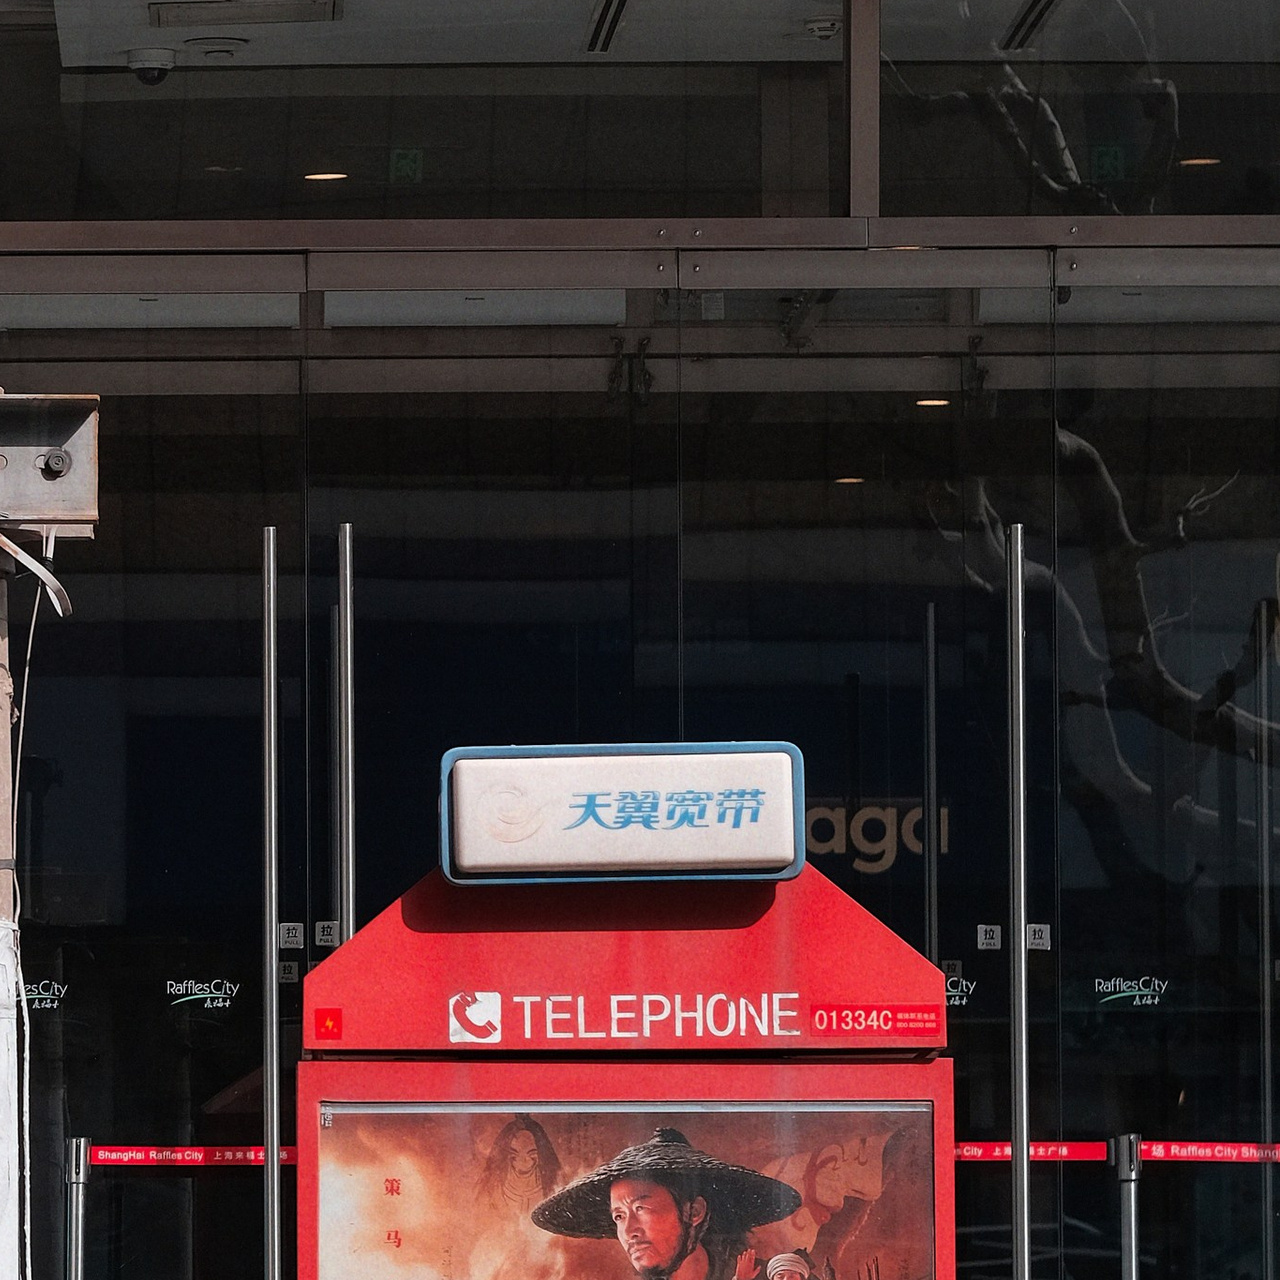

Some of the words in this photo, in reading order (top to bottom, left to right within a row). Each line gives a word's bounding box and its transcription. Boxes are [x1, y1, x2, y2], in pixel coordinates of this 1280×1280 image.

[562, 788, 766, 831] 天翼宽带
[286, 926, 298, 939] 拉
[321, 924, 333, 938] 拉
[984, 928, 995, 941] 拉
[1032, 927, 1045, 941] 拉
[39, 980, 68, 998] City
[166, 979, 210, 994] Raffles
[210, 979, 240, 997] City
[946, 977, 977, 995] City
[1094, 977, 1138, 992] Raffles
[1139, 976, 1168, 994] City
[513, 992, 801, 1039] TELEPHONE
[815, 1010, 892, 1030] 01334C
[98, 1150, 145, 1161] ShangHai
[150, 1150, 182, 1160] Raffles
[184, 1150, 204, 1161] City
[214, 1151, 288, 1160] 上海来福士场
[963, 1146, 983, 1157] City
[1170, 1144, 1212, 1157] Raffles
[1215, 1145, 1238, 1159] City
